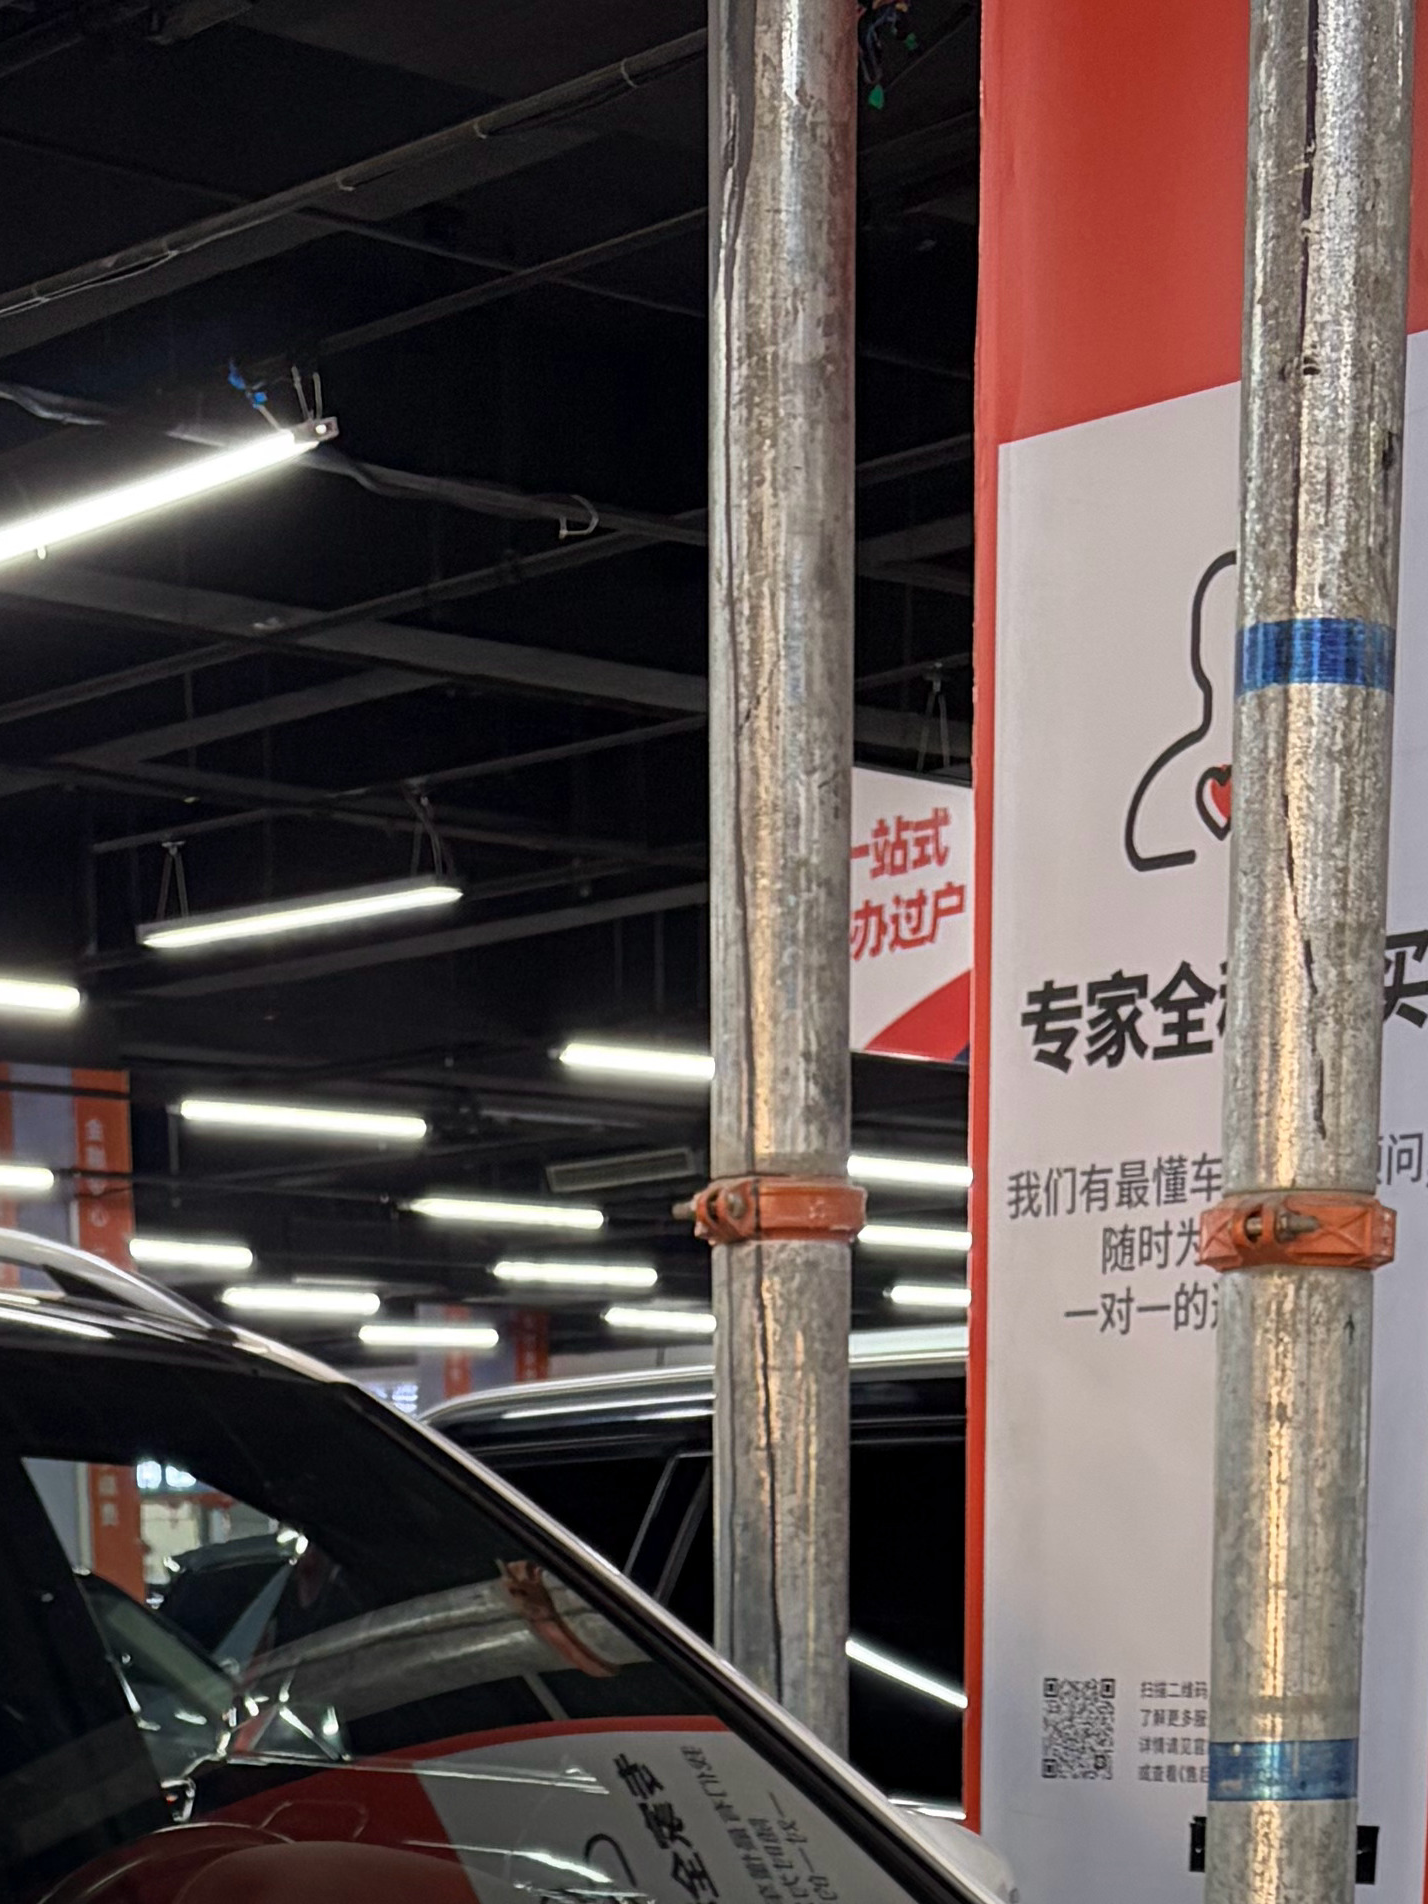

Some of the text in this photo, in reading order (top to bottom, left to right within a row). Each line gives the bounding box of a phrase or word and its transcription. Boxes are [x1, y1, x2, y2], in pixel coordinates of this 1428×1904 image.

[1021, 959, 1229, 1074] 专家全
[1064, 1281, 1219, 1337] 一对一的
